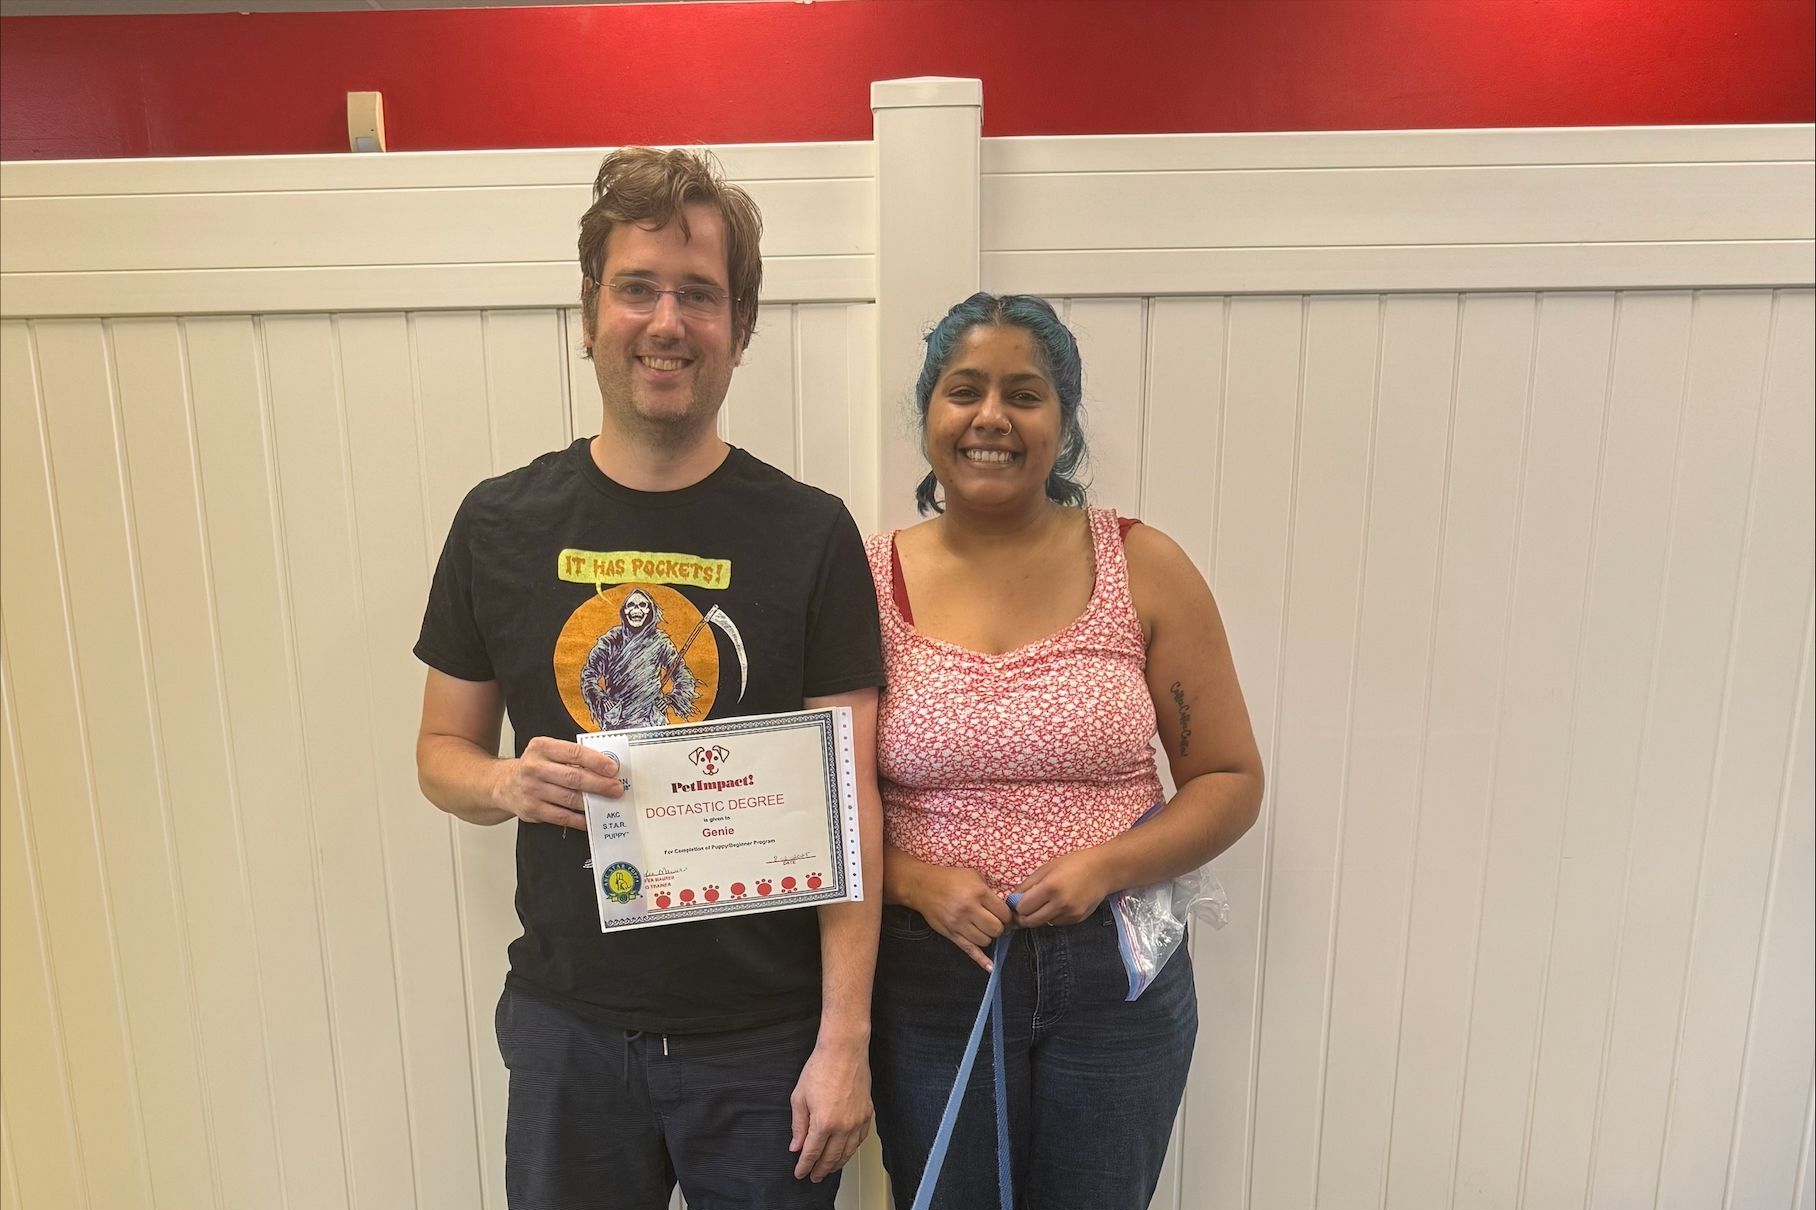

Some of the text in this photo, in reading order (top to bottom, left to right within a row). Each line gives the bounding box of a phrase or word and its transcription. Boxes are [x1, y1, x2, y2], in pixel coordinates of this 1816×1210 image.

[565, 555, 724, 585] IT HAS POCKETS!
[671, 774, 754, 793] PetImpact!
[606, 811, 621, 819] AKC
[645, 794, 785, 819] DOGTASTIC DEGREE
[702, 826, 735, 838] Genie
[674, 846, 704, 854] Completion
[753, 838, 776, 846] Program
